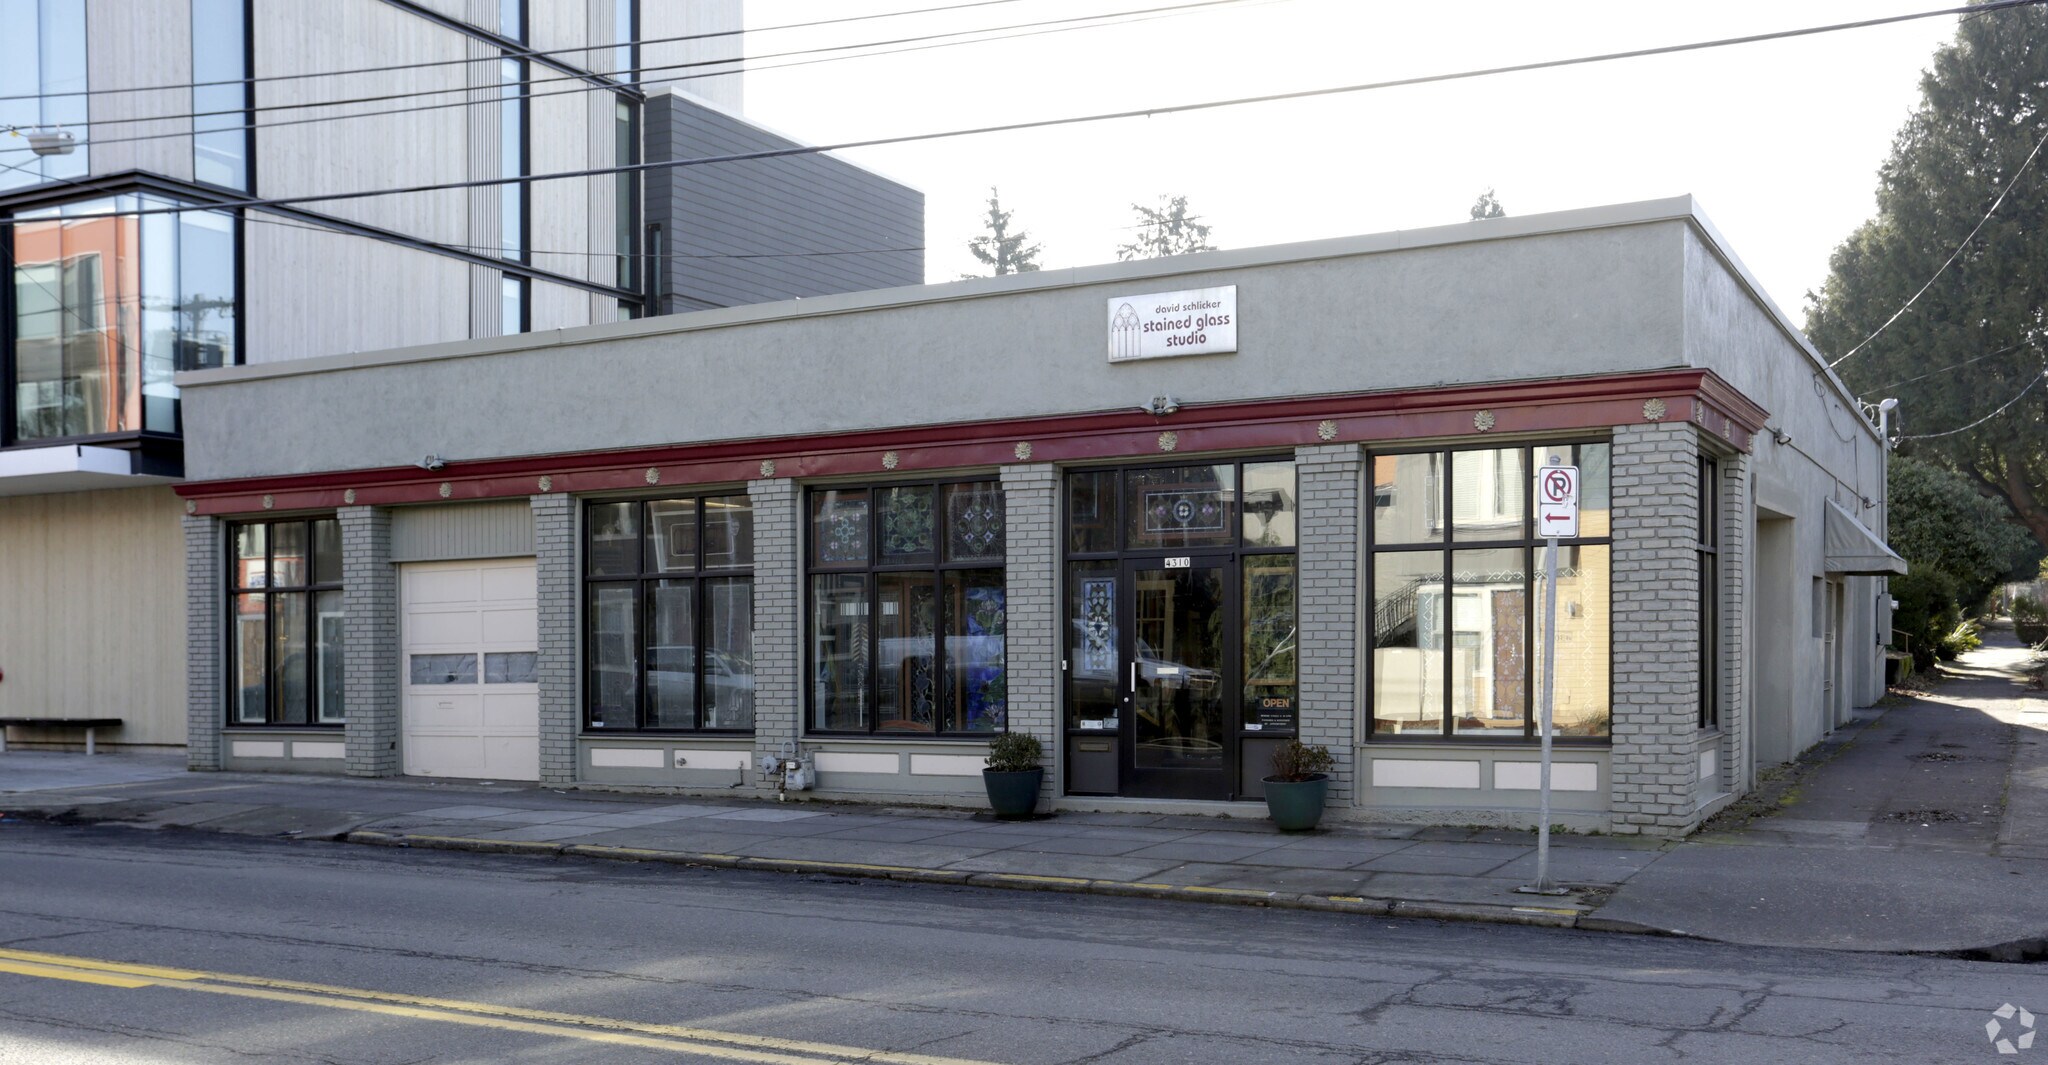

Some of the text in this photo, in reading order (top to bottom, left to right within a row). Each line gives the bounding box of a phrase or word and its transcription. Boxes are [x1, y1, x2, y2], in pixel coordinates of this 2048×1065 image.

[1155, 301, 1221, 313] david schlicker
[1143, 313, 1230, 333] stained glass
[1166, 331, 1207, 347] studio
[1553, 477, 1566, 496] P
[1166, 558, 1189, 567] 4310
[1264, 698, 1289, 707] OPEN
